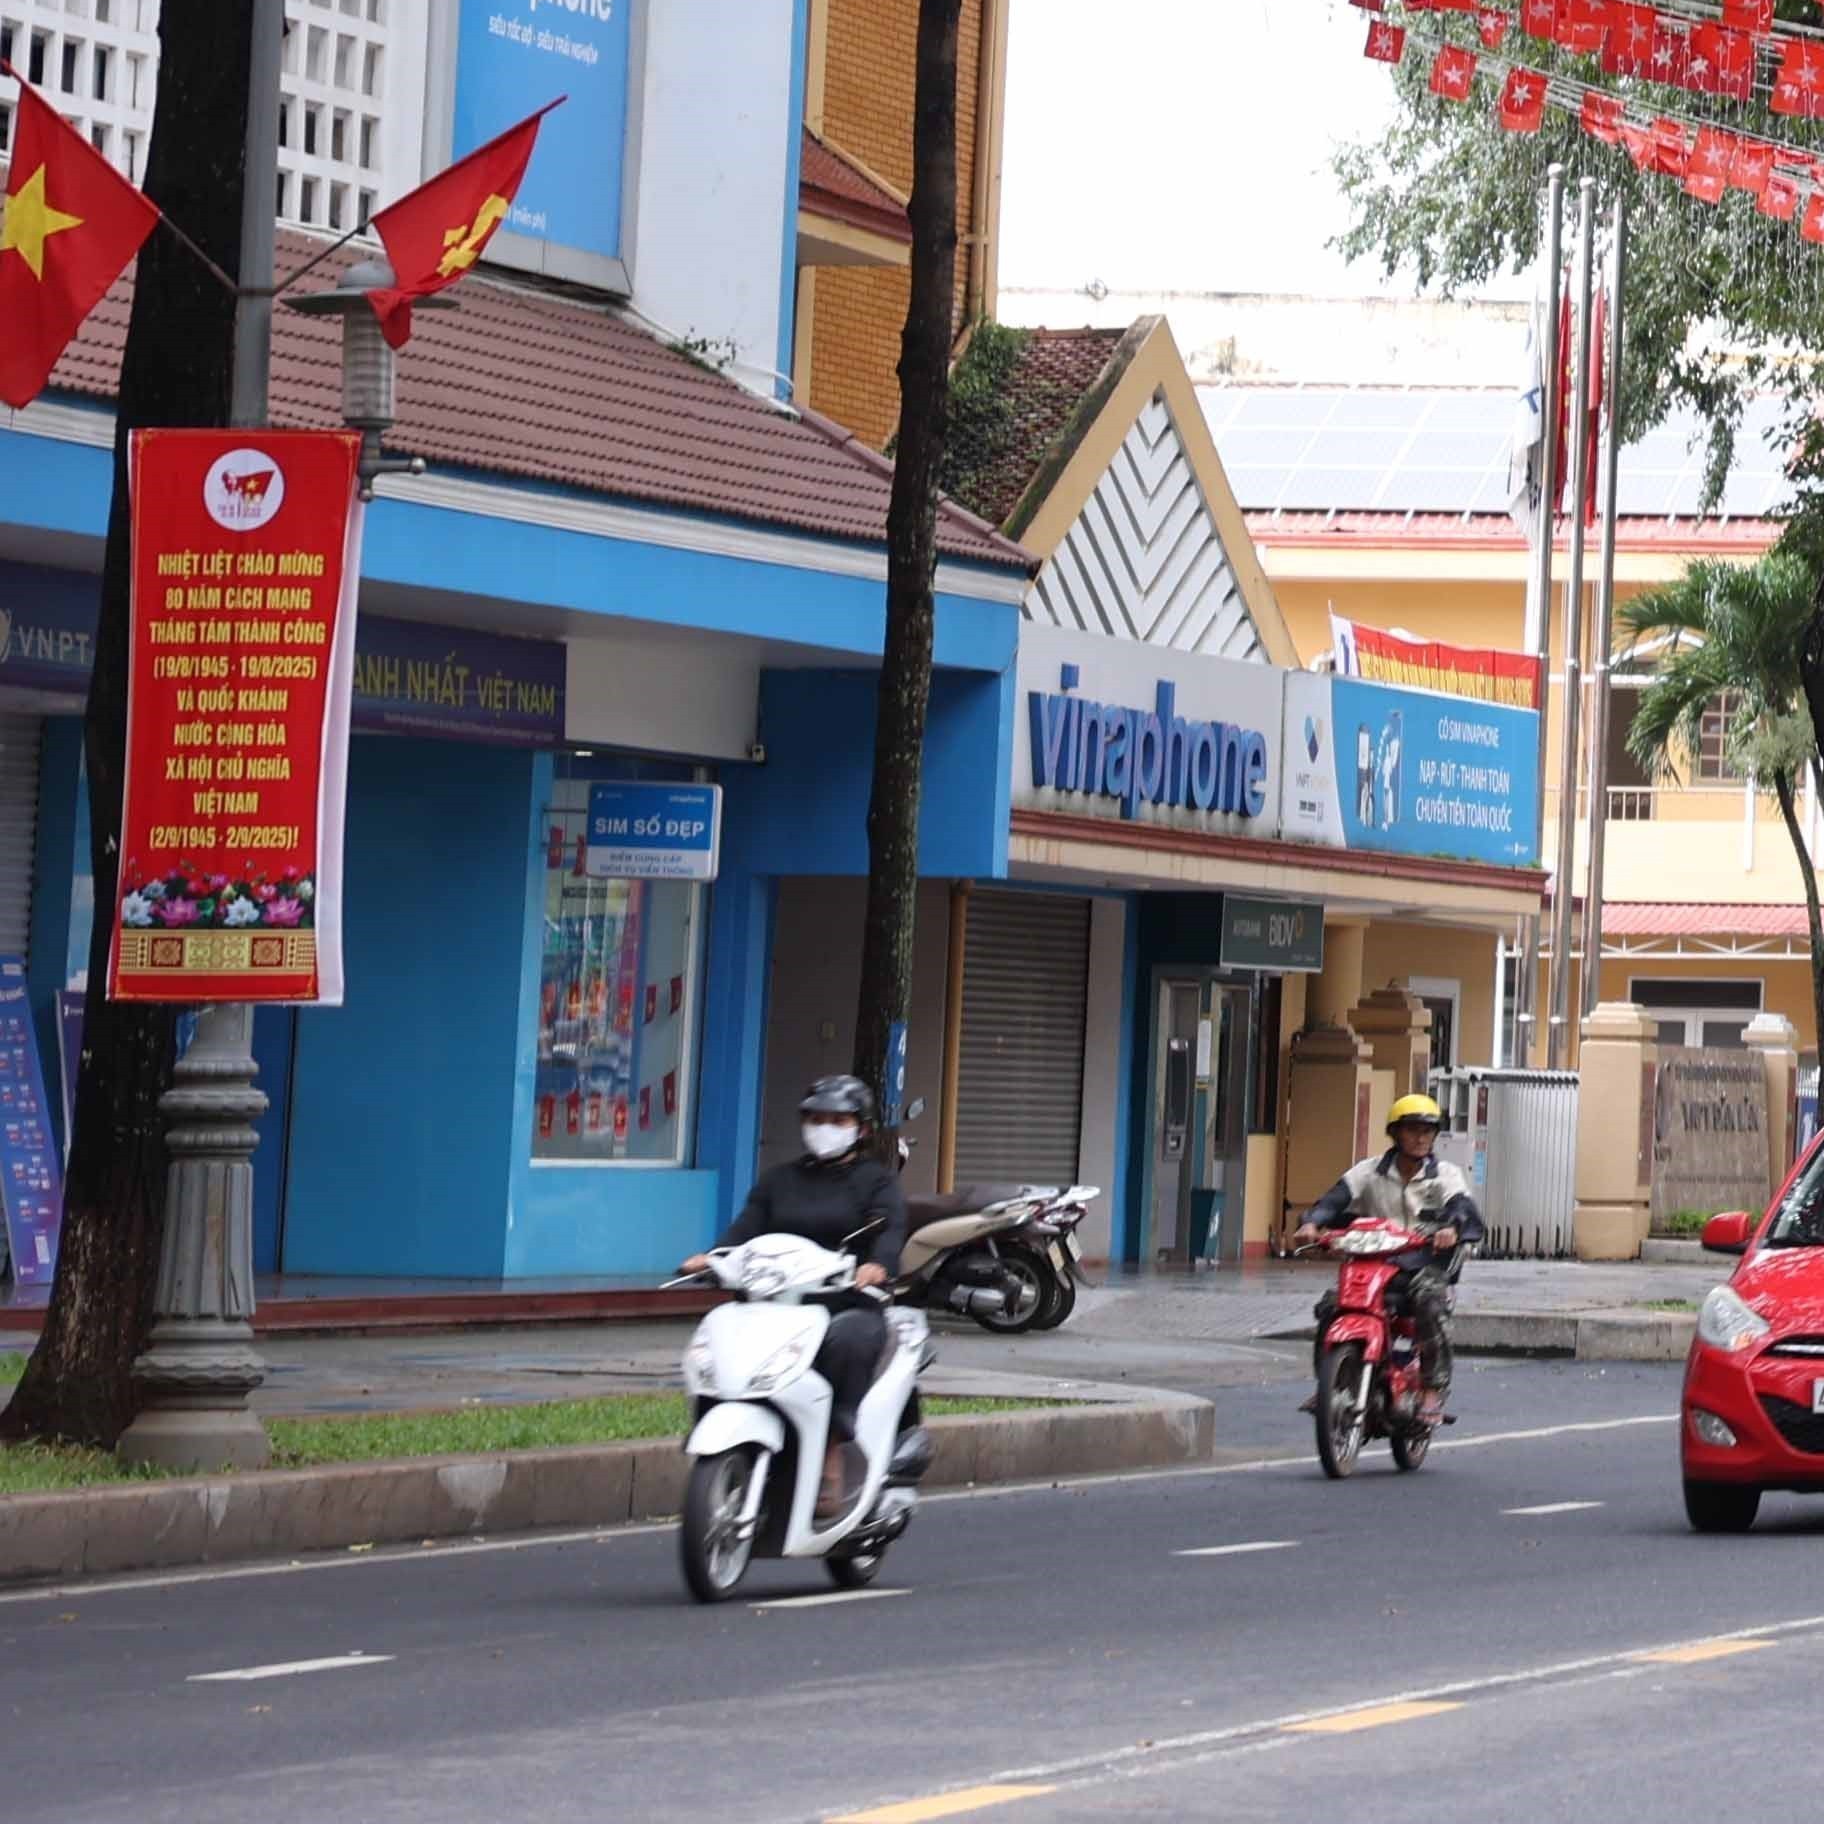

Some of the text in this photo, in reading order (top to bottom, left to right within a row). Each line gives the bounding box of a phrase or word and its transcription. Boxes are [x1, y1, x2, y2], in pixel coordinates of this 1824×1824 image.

[158, 548, 324, 580] NHIỆT LIỆT CHÀO MỪNG
[166, 583, 312, 615] 80 NĂM CÁCH MẠNG
[18, 625, 91, 665] VNPT
[150, 616, 326, 644] THÁNG TÁM THÀNH CÔNG
[153, 656, 229, 680] (19/8/1945
[240, 656, 317, 680] 19/8/2025)
[177, 681, 288, 714] VÀ QUỐC KHÁNH
[407, 651, 470, 708] NHẤT
[477, 670, 513, 717] VIỆT
[517, 681, 555, 719] NAM
[174, 718, 286, 750] NƯỚC CỘNG HÒA
[1028, 662, 1267, 821] vinaphone
[165, 750, 291, 784] XÃ HỘI CHỦ NGHĨA
[1419, 759, 1437, 789] NẠP
[1460, 765, 1487, 791] THANH
[193, 787, 259, 819] VIỆT NAM
[150, 826, 216, 850] (2/9/1945
[225, 826, 299, 850] 2/9/2025)!
[595, 811, 705, 840] SIM SỐ ĐẸP
